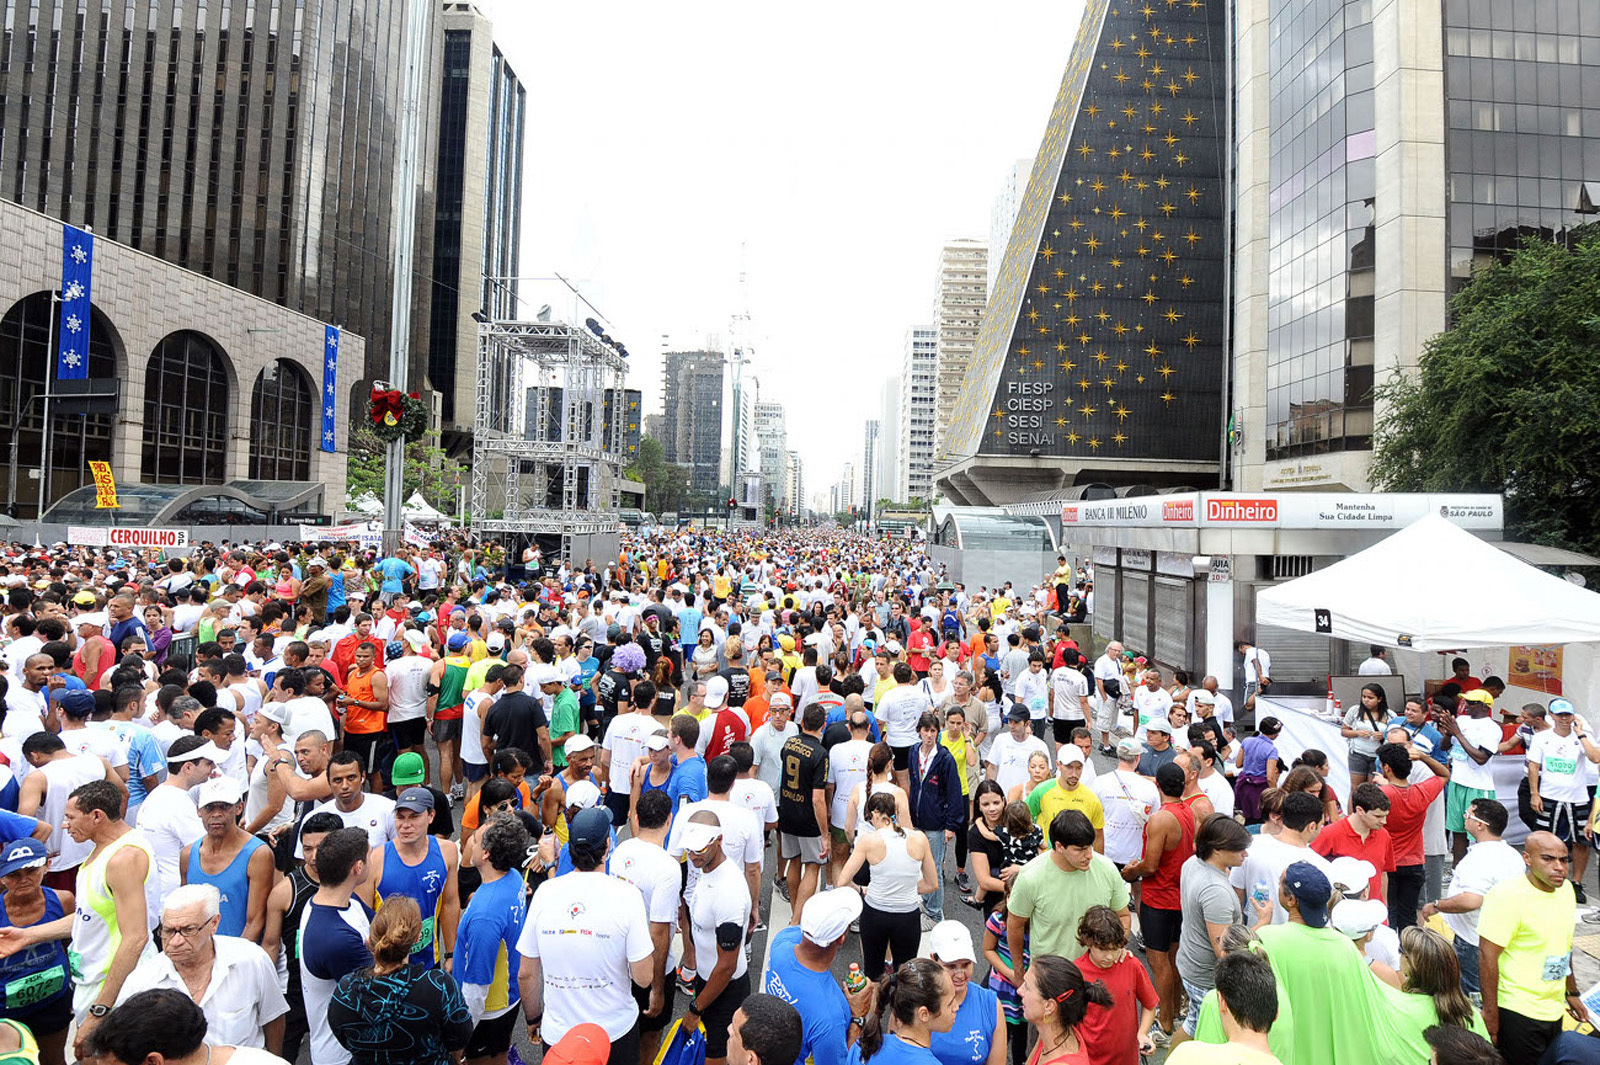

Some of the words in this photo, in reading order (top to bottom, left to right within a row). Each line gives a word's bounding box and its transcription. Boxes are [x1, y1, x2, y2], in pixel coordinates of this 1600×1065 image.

[1008, 382, 1054, 394] FIESP
[1007, 398, 1054, 411] CIESP
[1008, 415, 1043, 428] SESI
[1008, 432, 1056, 445] SENAI
[1085, 508, 1105, 520] BANCA
[1162, 503, 1193, 520] Dinheiro
[1209, 501, 1276, 519] Dinheiro
[1319, 512, 1334, 520] Sua
[1368, 513, 1393, 521] Limpa
[111, 529, 176, 545] CERQUILHO
[1318, 615, 1329, 627] 34
[787, 755, 800, 789] 9
[16, 978, 54, 999] 6072
